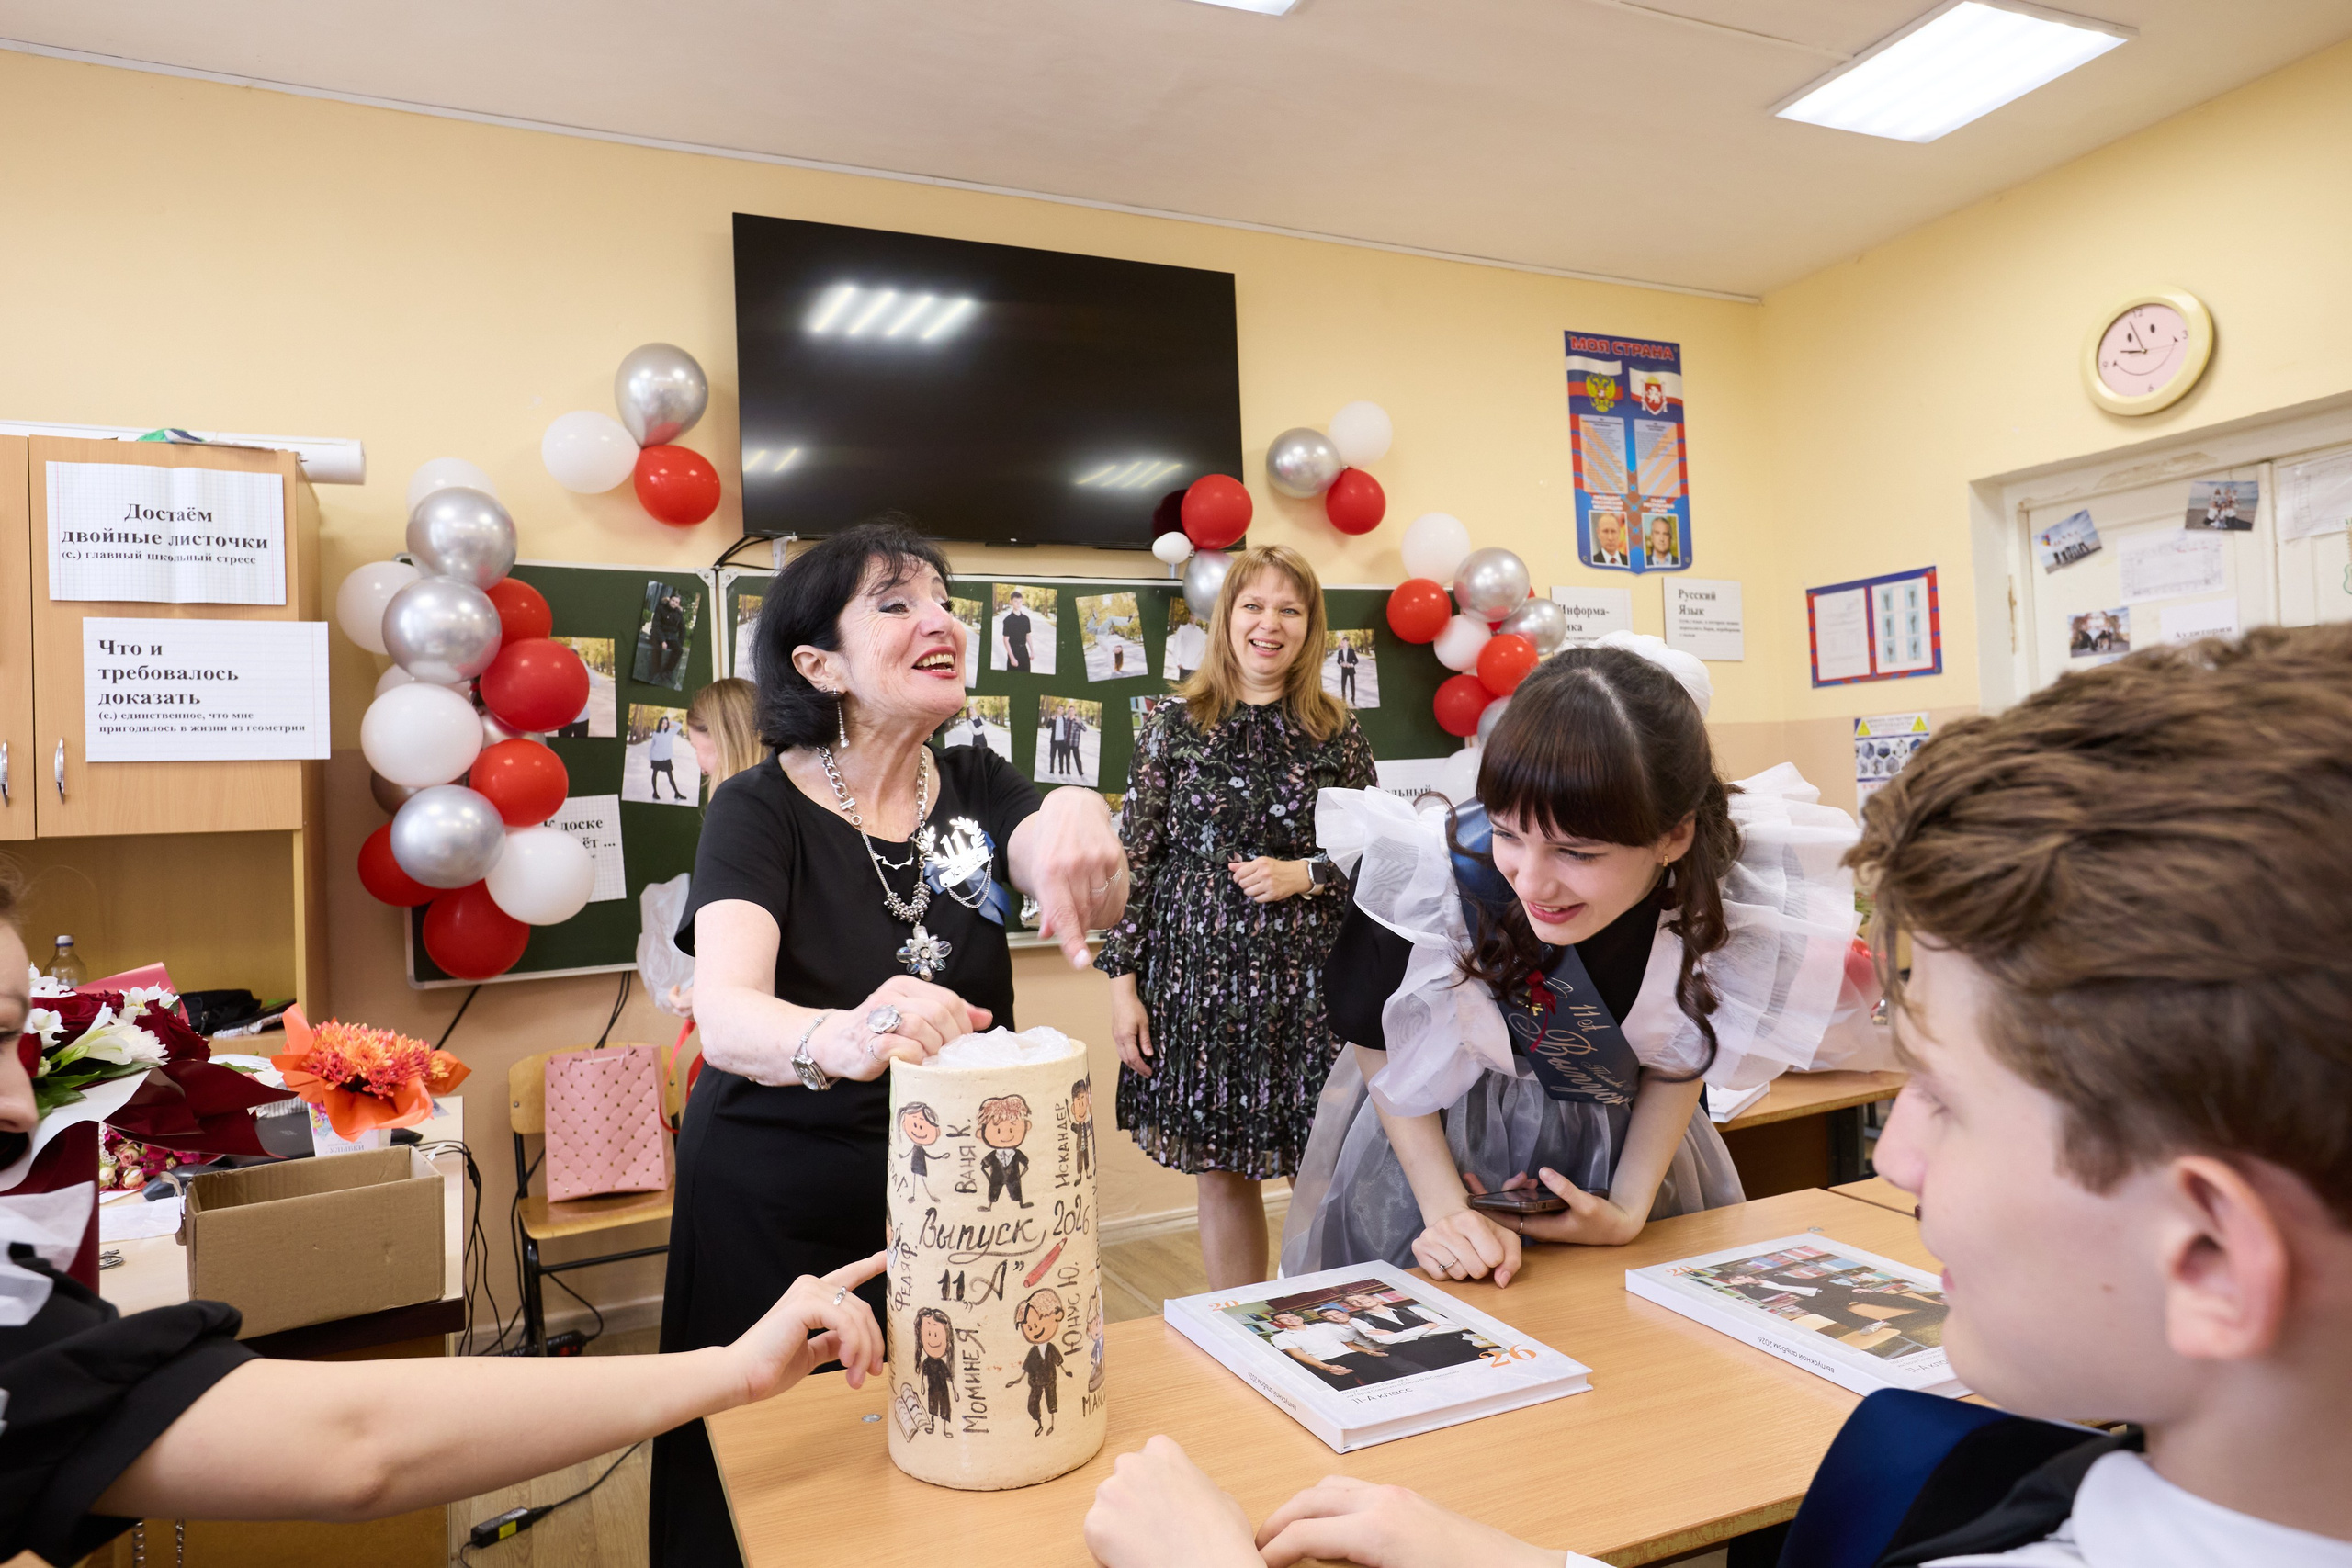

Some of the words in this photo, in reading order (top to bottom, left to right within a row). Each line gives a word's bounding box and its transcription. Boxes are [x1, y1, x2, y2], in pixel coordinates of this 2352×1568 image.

[1570, 336, 1610, 354] МОЯ
[1611, 341, 1675, 361] СТРАНА
[124, 503, 212, 523] Достаём
[62, 528, 162, 545] двойные
[168, 534, 268, 549] листочки
[62, 550, 82, 560] (с.)
[85, 550, 142, 560] главный
[147, 552, 212, 562] школьный
[216, 555, 256, 566] стресс
[1679, 588, 1716, 602] Русский
[1679, 604, 1704, 616] Язык
[98, 639, 142, 656] Что
[150, 644, 163, 656] и
[98, 665, 239, 684] требовалось
[98, 693, 201, 706] доказать
[98, 712, 118, 722] (с.)
[120, 713, 206, 722] единственное,
[209, 713, 229, 721] что
[232, 713, 254, 721] мне
[99, 725, 176, 735] пригодилось
[231, 725, 243, 733] из
[246, 725, 306, 734] геометрии
[940, 830, 968, 859] 11
[919, 1206, 1046, 1265] Выпуск
[1052, 1194, 1091, 1236] 2026
[937, 1269, 965, 1301] 11
[1208, 1300, 1239, 1311] 20
[1758, 1336, 1773, 1348] 2026
[1773, 1342, 1798, 1358] альбом
[1479, 1344, 1537, 1368] 26
[1798, 1353, 1835, 1373] выпускной
[1377, 1387, 1413, 1398] класс
